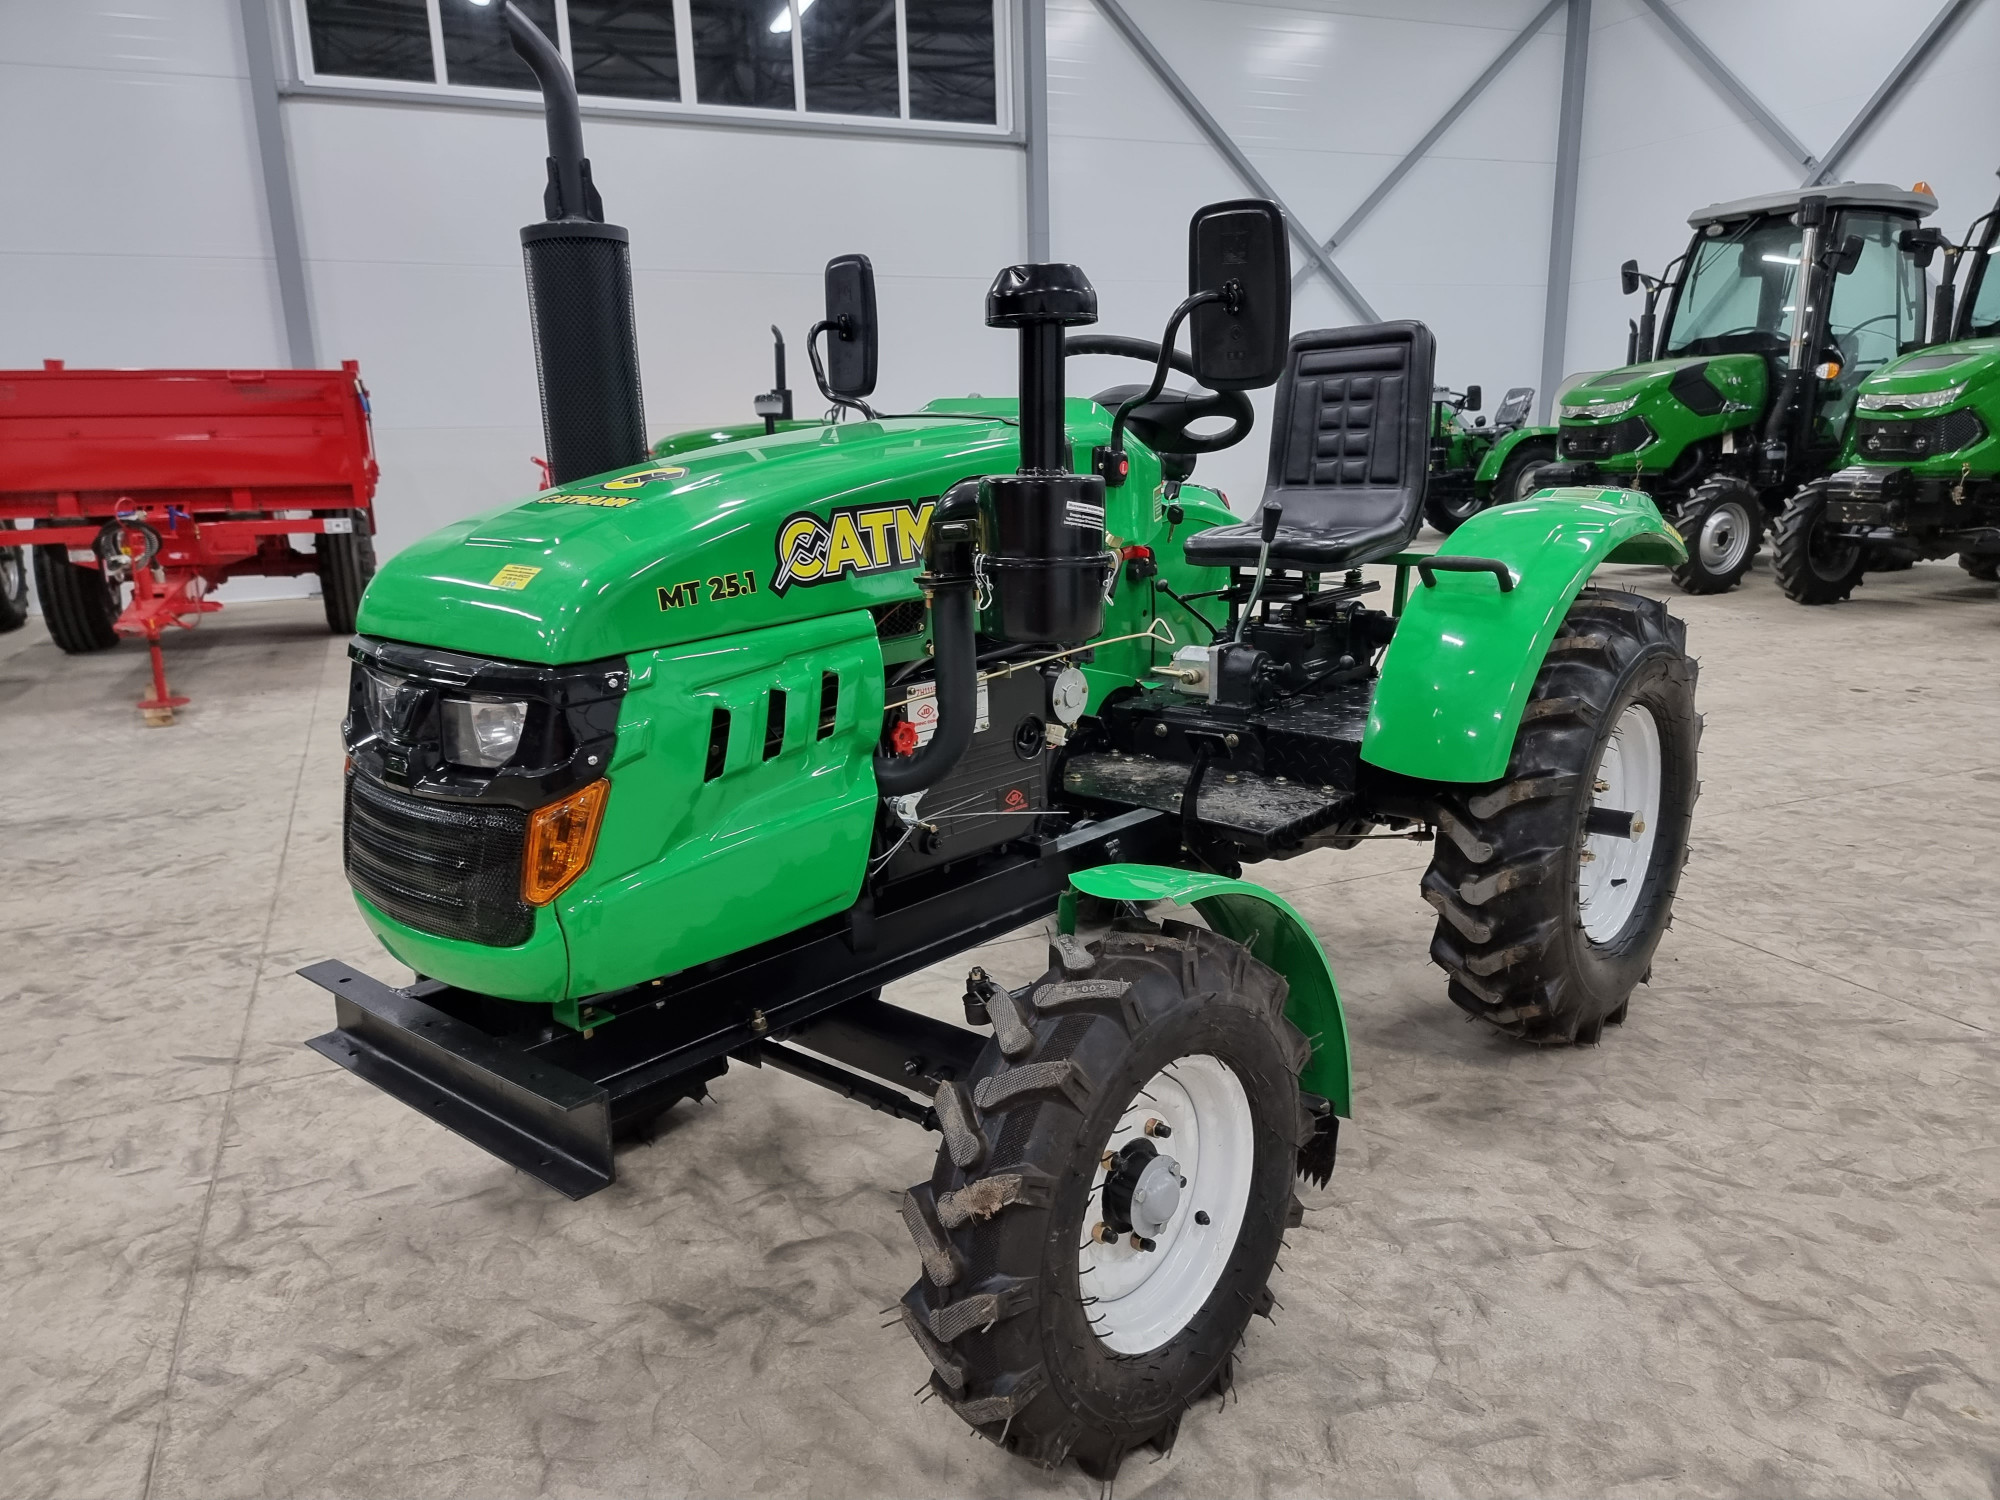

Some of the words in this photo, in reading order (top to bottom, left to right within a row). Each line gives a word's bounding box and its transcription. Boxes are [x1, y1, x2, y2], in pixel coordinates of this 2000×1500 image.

[773, 500, 938, 590] CATM
[656, 580, 701, 612] MT
[706, 570, 757, 601] 25.1
